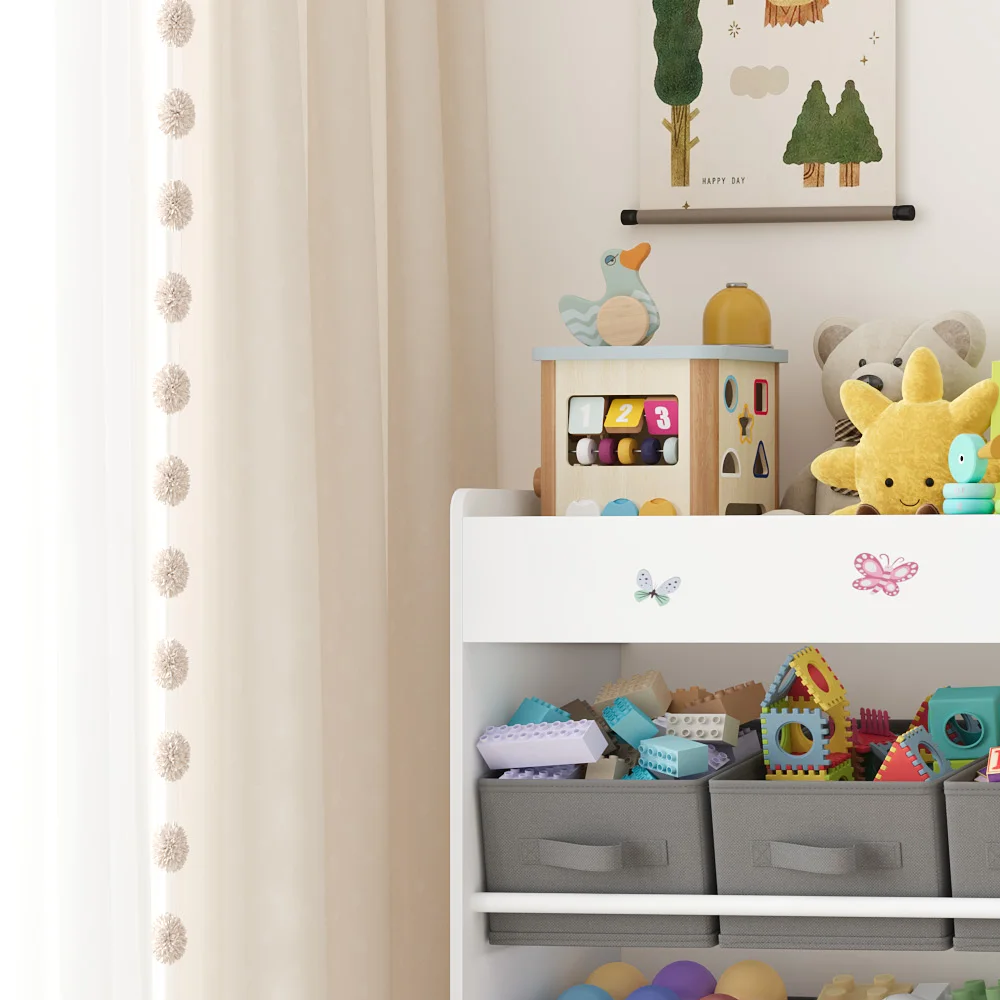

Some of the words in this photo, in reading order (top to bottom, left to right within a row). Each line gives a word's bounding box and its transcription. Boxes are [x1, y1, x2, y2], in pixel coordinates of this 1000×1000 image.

[702, 177, 726, 185] HAPPY
[731, 176, 746, 185] DAY
[580, 403, 591, 428] 1
[615, 404, 633, 422] 2
[654, 406, 671, 430] 3
